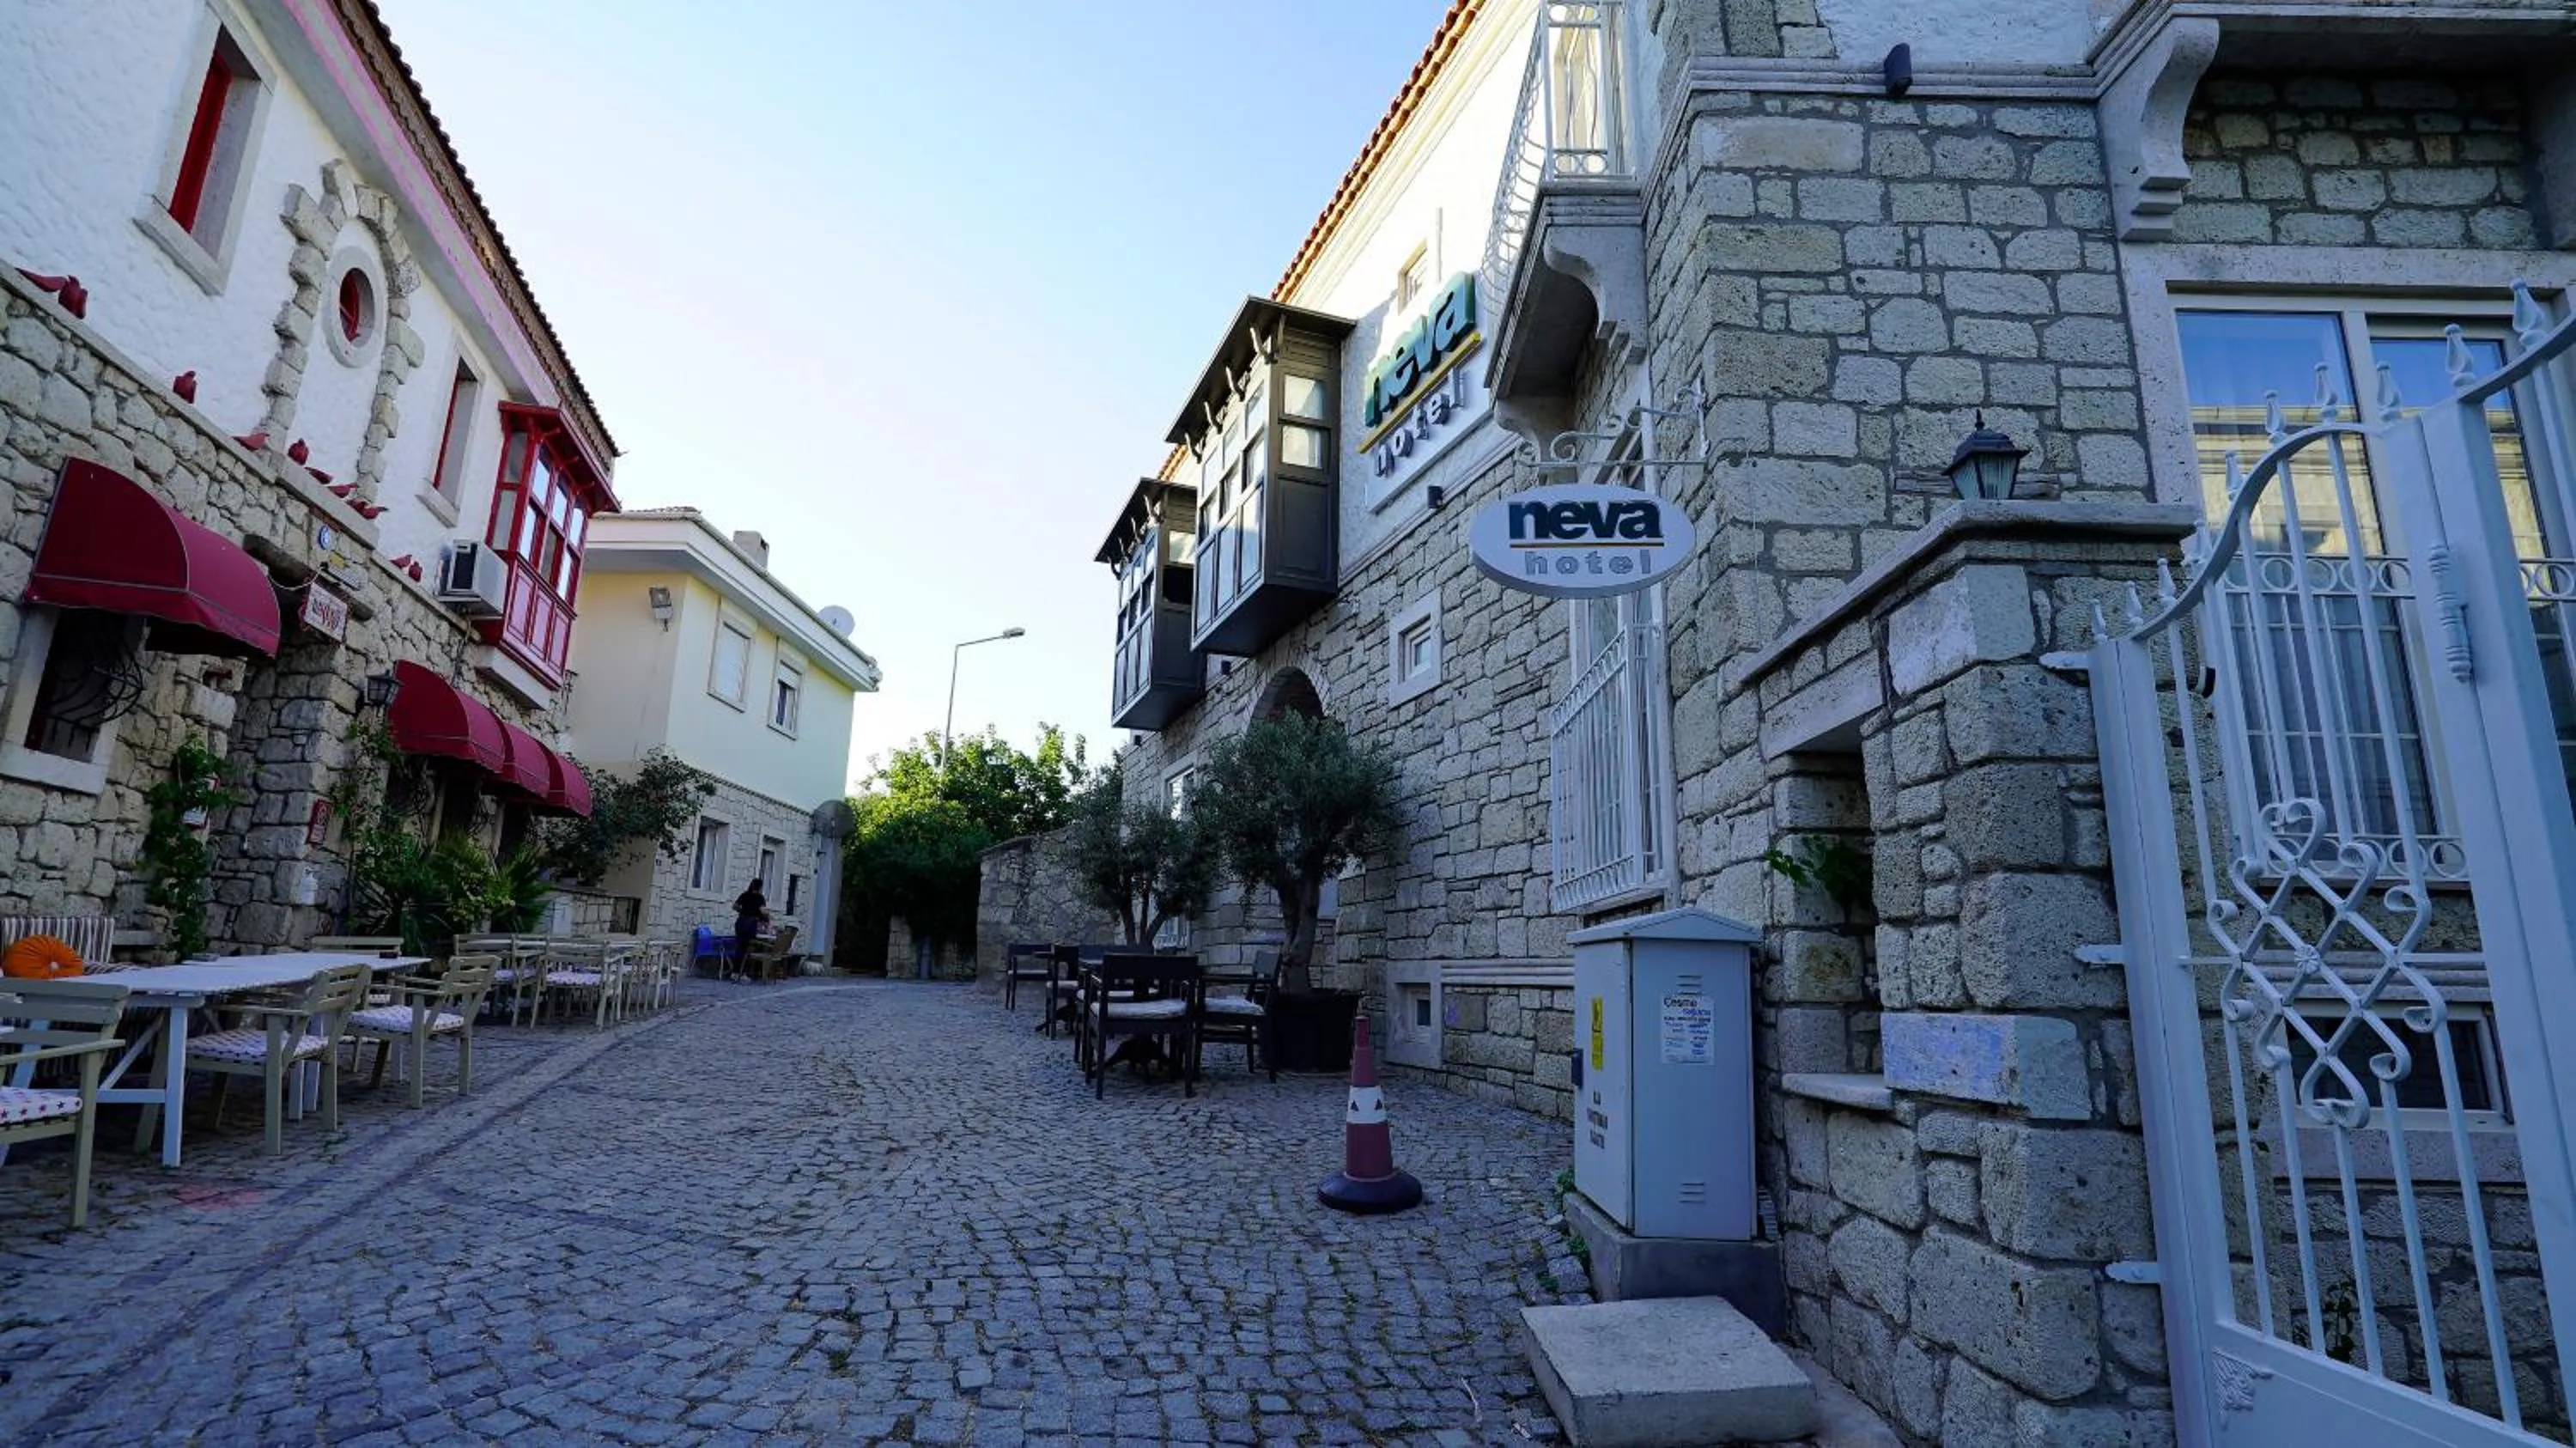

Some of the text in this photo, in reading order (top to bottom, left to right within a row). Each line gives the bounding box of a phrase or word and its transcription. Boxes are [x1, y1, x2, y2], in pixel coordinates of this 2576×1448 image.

[1364, 271, 1476, 428] neva
[1508, 501, 1663, 539] neva
[1524, 550, 1652, 575] hotel
